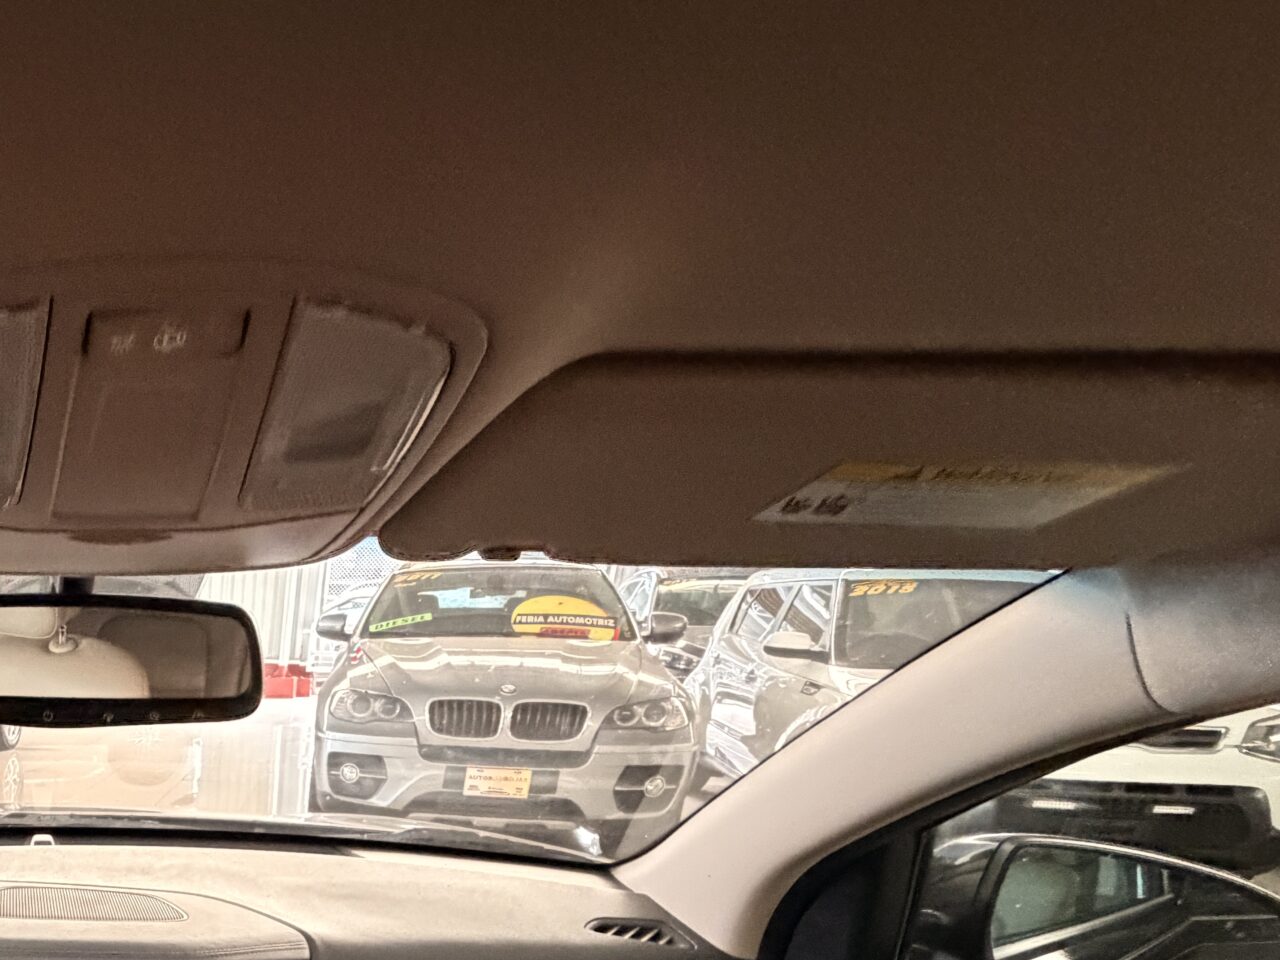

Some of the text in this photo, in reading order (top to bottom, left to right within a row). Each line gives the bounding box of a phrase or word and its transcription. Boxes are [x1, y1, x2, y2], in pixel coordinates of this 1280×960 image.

[374, 615, 427, 631] DIESEL
[515, 615, 616, 627] FERIA AUTOMOTRIZ
